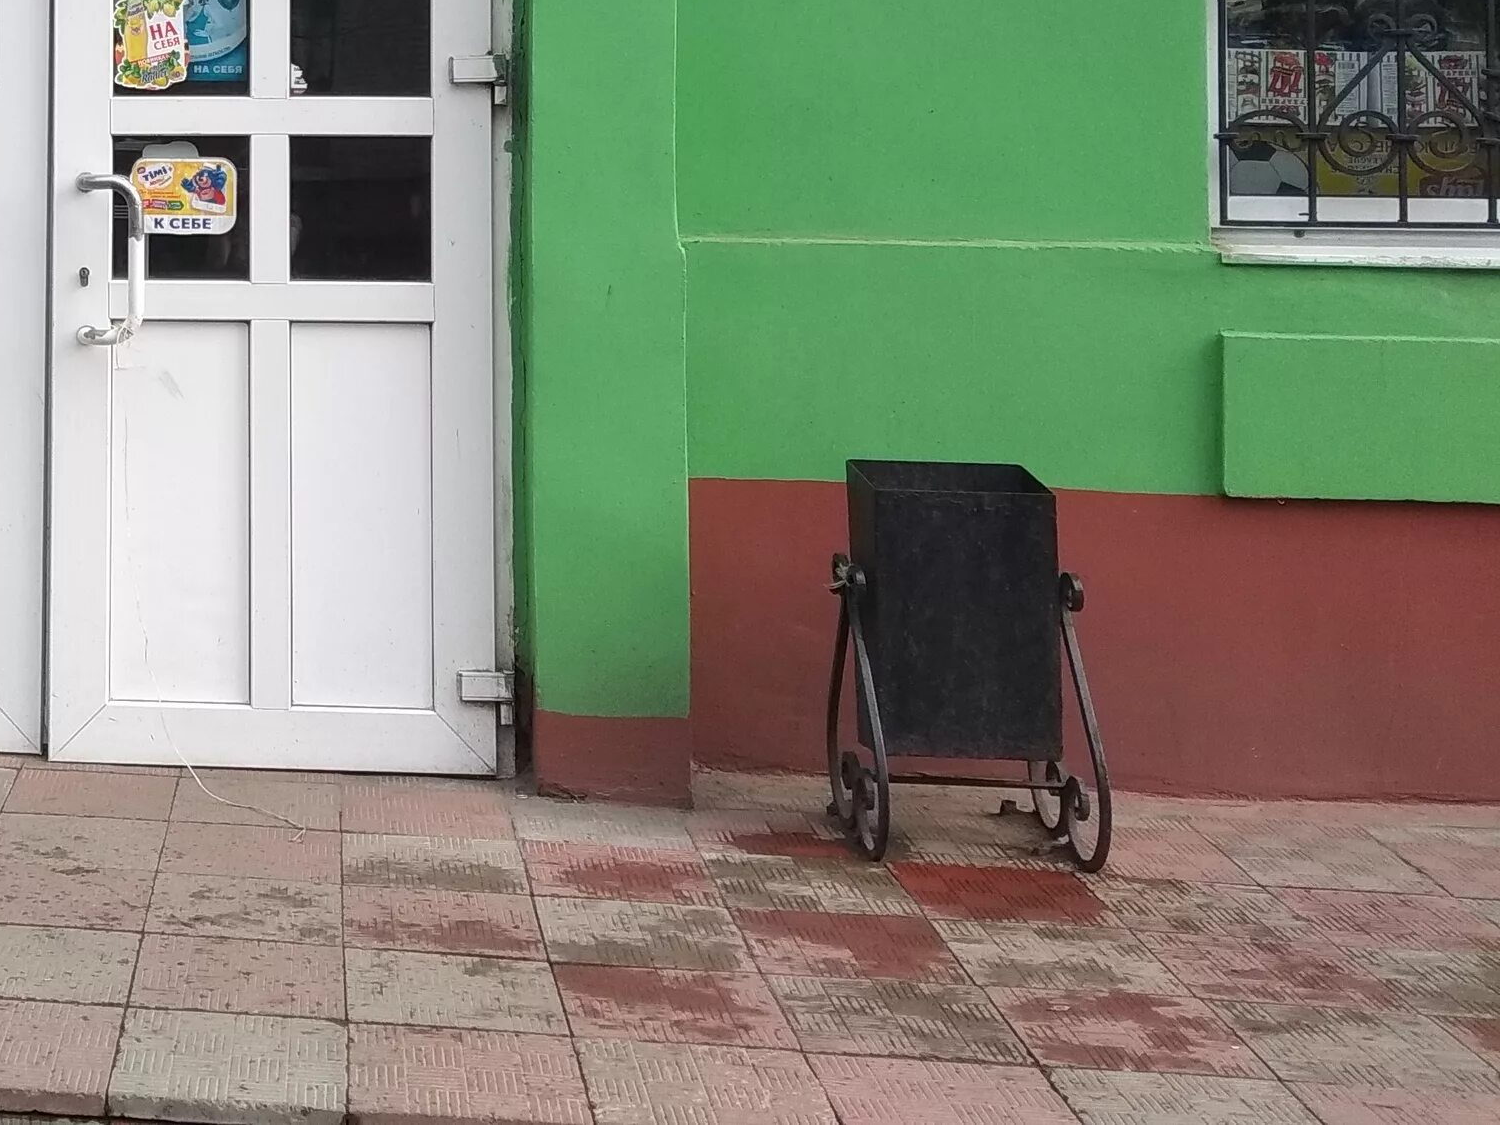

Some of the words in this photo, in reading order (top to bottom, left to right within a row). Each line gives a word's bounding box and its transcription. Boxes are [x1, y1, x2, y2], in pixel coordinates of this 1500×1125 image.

[149, 21, 179, 42] НА
[153, 36, 181, 51] СЕБЯ
[193, 65, 210, 74] НА
[213, 65, 243, 74] СЕБЯ
[153, 218, 165, 229] К
[169, 218, 212, 230] СЕБЕ
